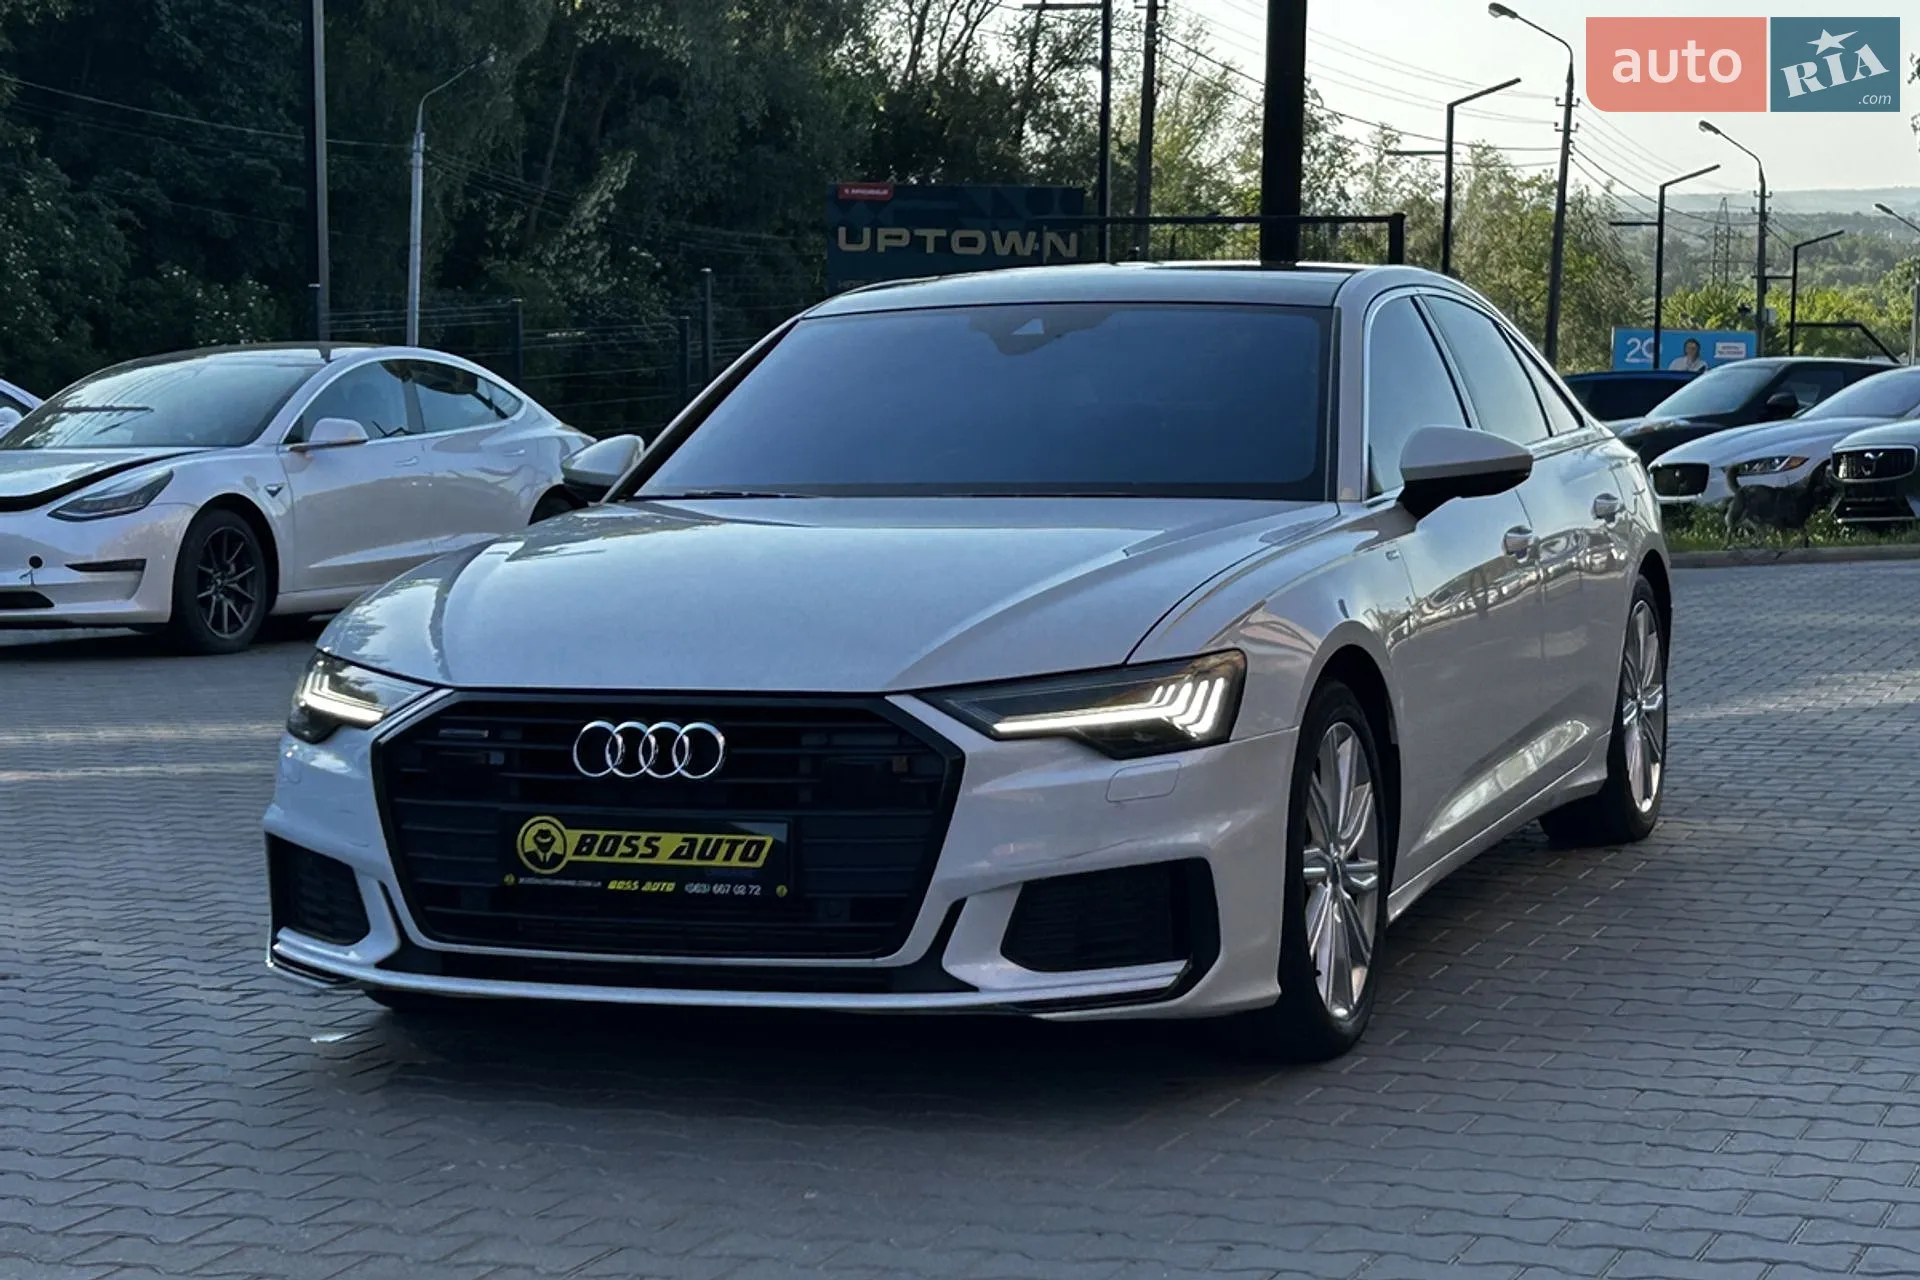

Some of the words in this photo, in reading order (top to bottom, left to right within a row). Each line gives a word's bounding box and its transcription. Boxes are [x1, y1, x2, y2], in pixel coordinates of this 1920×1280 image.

[838, 226, 1078, 258] UPTOWN
[572, 833, 662, 858] BOSS
[669, 836, 767, 862] AUTO
[607, 880, 639, 891] BOSS
[641, 881, 676, 892] AUTO
